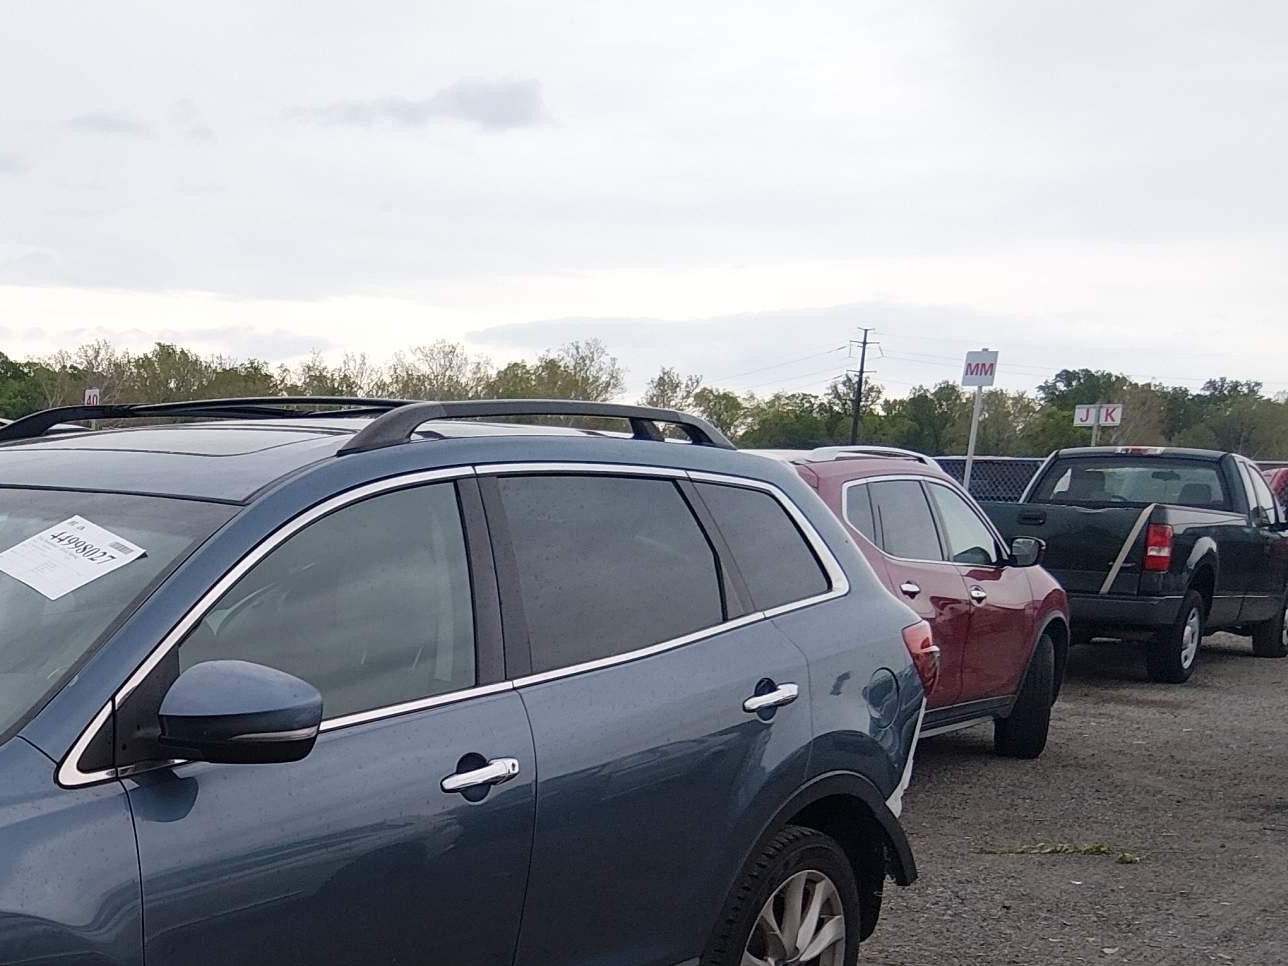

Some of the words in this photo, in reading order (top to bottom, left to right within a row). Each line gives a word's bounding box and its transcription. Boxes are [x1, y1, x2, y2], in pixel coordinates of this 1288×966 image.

[965, 362, 995, 377] MM
[1079, 410, 1090, 423] J
[1104, 409, 1116, 423] K
[50, 530, 117, 565] 44998027
